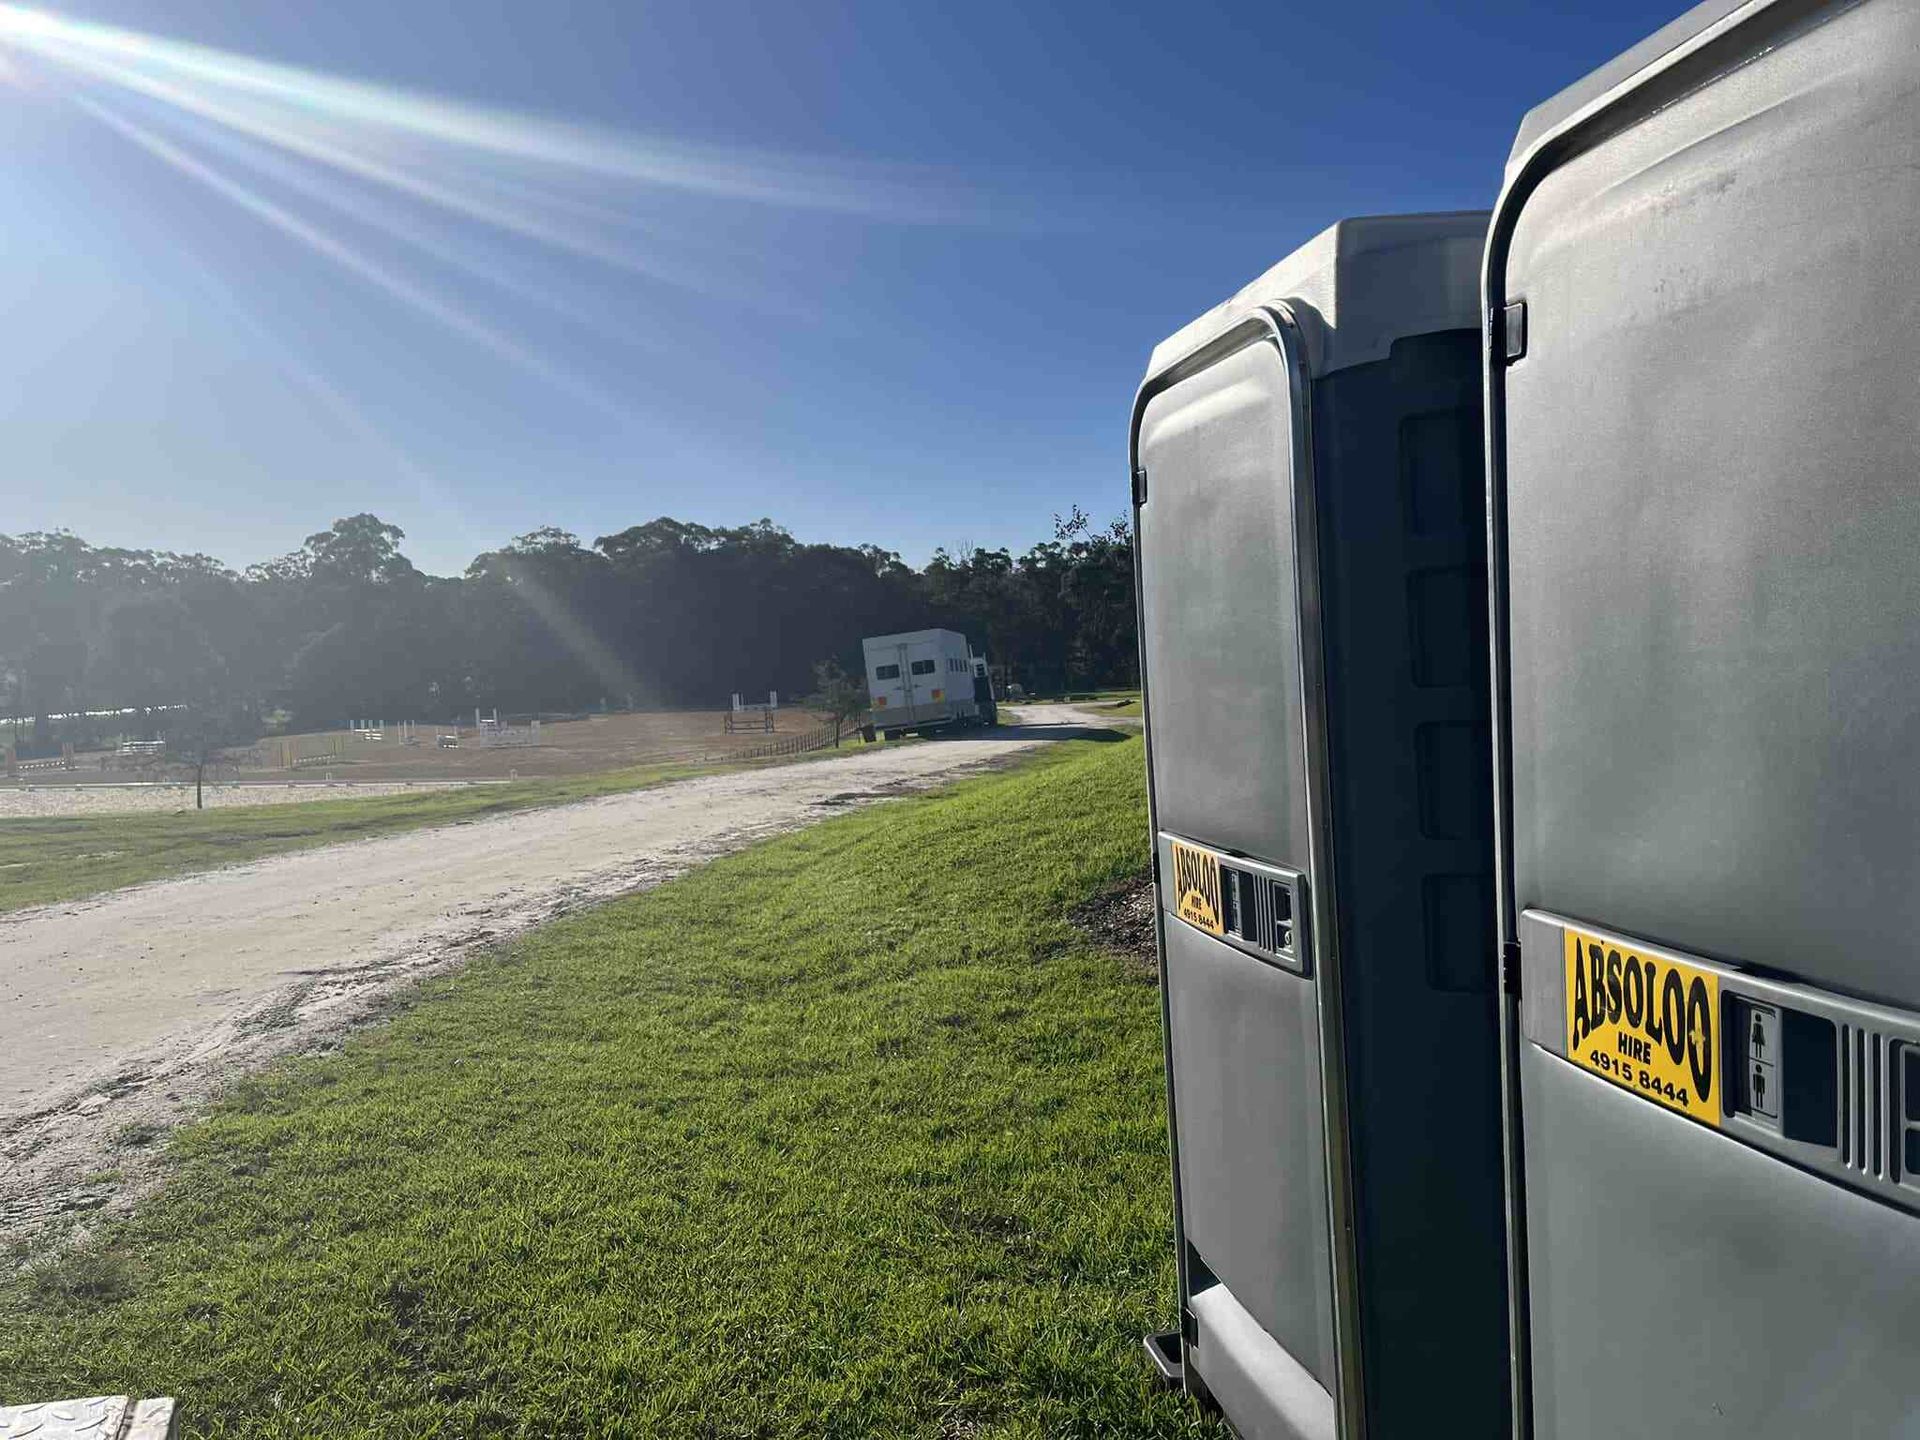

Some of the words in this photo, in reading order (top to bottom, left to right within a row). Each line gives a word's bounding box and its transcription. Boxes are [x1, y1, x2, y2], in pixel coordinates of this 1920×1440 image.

[1176, 845, 1220, 925] ABSOLOO
[1191, 896, 1202, 910] HIRE
[1184, 908, 1198, 922] 4915
[1198, 915, 1214, 929] 8444
[1573, 937, 1712, 1103] ABSOLOO
[1618, 1032, 1651, 1065] HIRE
[1590, 1050, 1633, 1081] 4915
[1639, 1070, 1689, 1107] 8444
